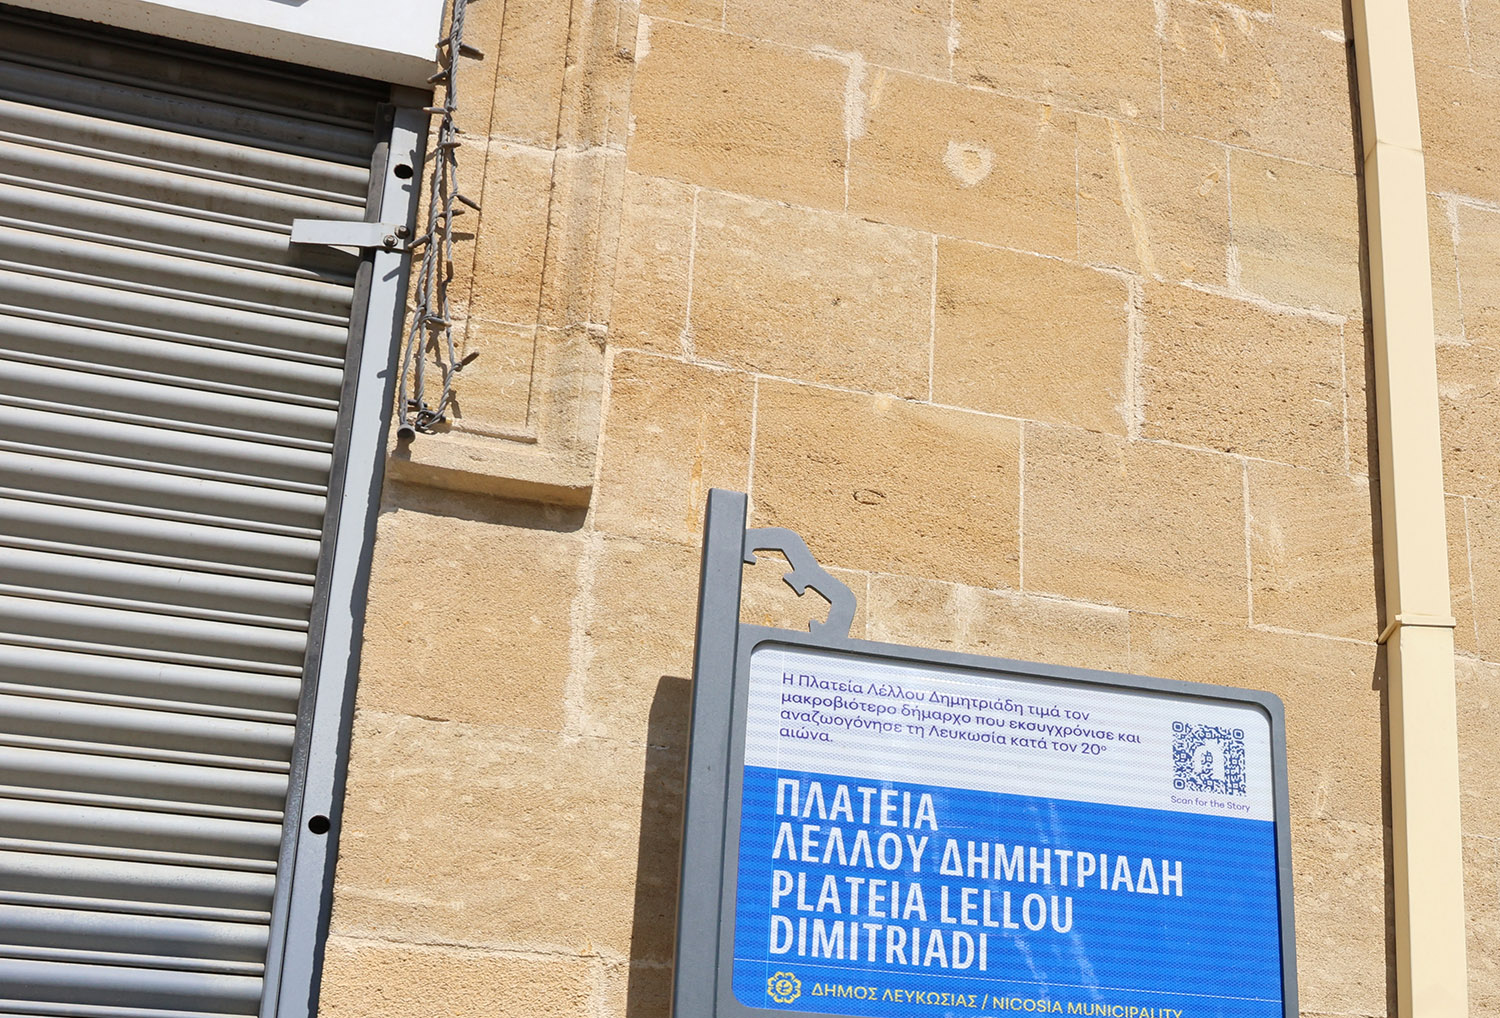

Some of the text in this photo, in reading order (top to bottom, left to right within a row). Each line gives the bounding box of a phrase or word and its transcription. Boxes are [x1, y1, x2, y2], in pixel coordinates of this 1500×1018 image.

[781, 692, 1141, 744] μακροβιότερο δήμαρχο που εκσυγχρόνισε και
[782, 672, 1090, 722] Η Πλατεία Λέλλου Δημητριάδη τιμά τον
[779, 725, 833, 742] αιώνα.
[780, 709, 902, 733] αναζωογόνησε
[906, 725, 924, 738] τη
[928, 725, 1006, 745] Λευκωσία
[1010, 735, 1047, 749] κατά
[1051, 740, 1078, 753] τον
[776, 777, 938, 831] ΠΛΑΤΕΙΑ
[1170, 795, 1250, 812] Scan for the Story
[772, 822, 1183, 896] ΛΕΛΛΟΥ ΔΗΜΗΤΡΙΑΔΗ
[771, 869, 1073, 933] PLATEIA LELLOU
[769, 915, 988, 971] DIMITRIADI
[811, 983, 878, 1000] ΔΗΜΟΣ
[882, 989, 978, 1008] ΛΕΥΚΩΣΙΑΣ
[993, 996, 1063, 1014] NICOSIA
